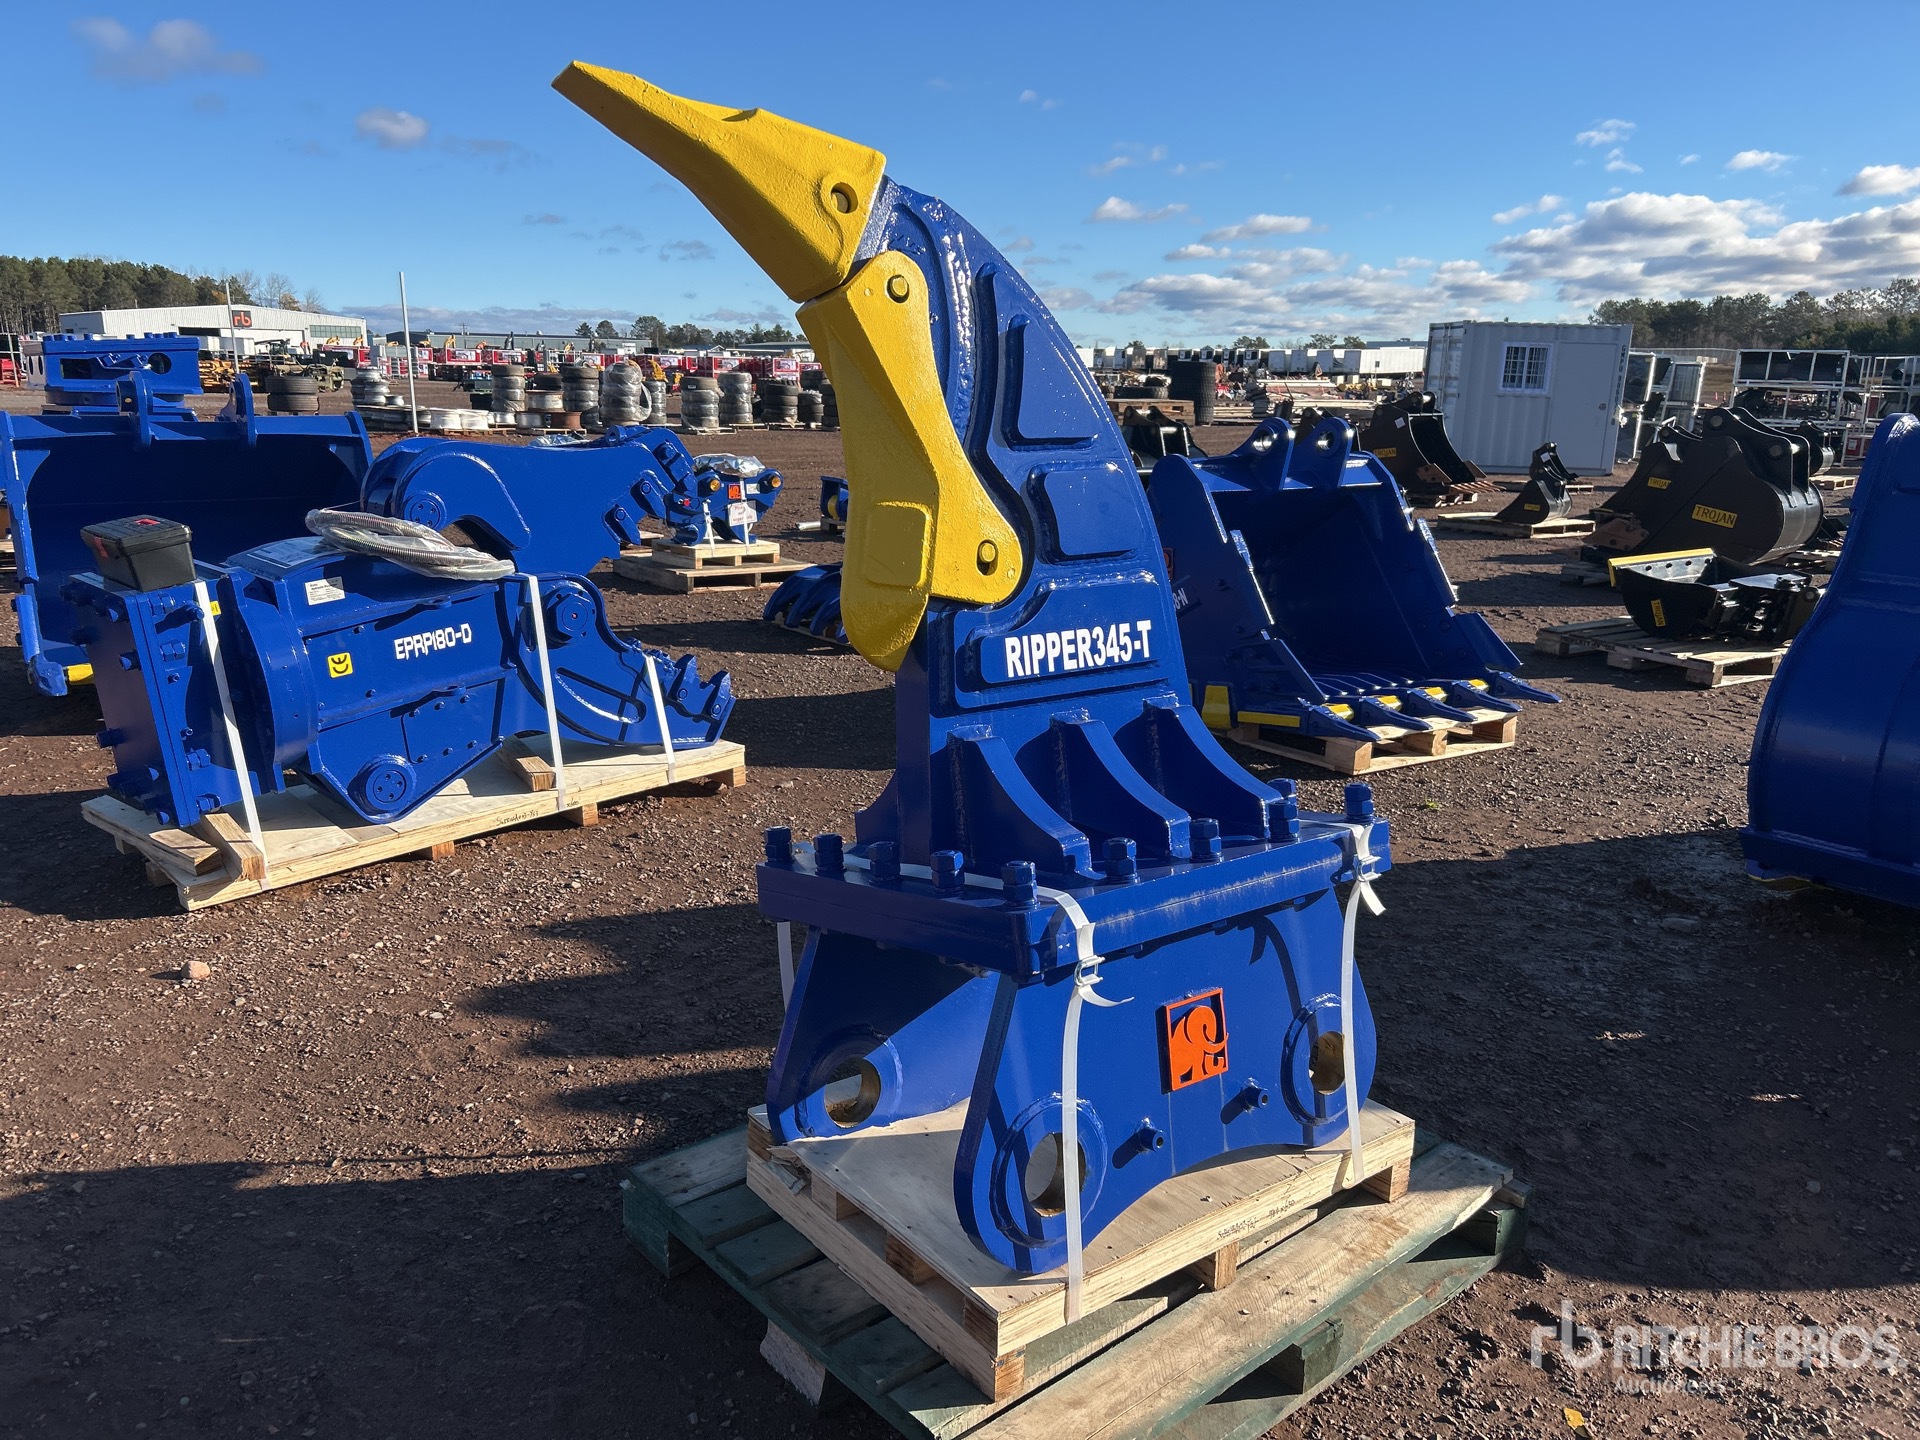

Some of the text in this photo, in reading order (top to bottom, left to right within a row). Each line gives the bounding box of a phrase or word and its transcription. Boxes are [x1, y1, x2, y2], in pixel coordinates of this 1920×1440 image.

[234, 312, 252, 326] rb
[1649, 478, 1670, 487] TROJA
[1695, 506, 1736, 525] TROJAN
[394, 623, 472, 660] EPRP180-D
[1005, 620, 1151, 678] RIPPER345-T
